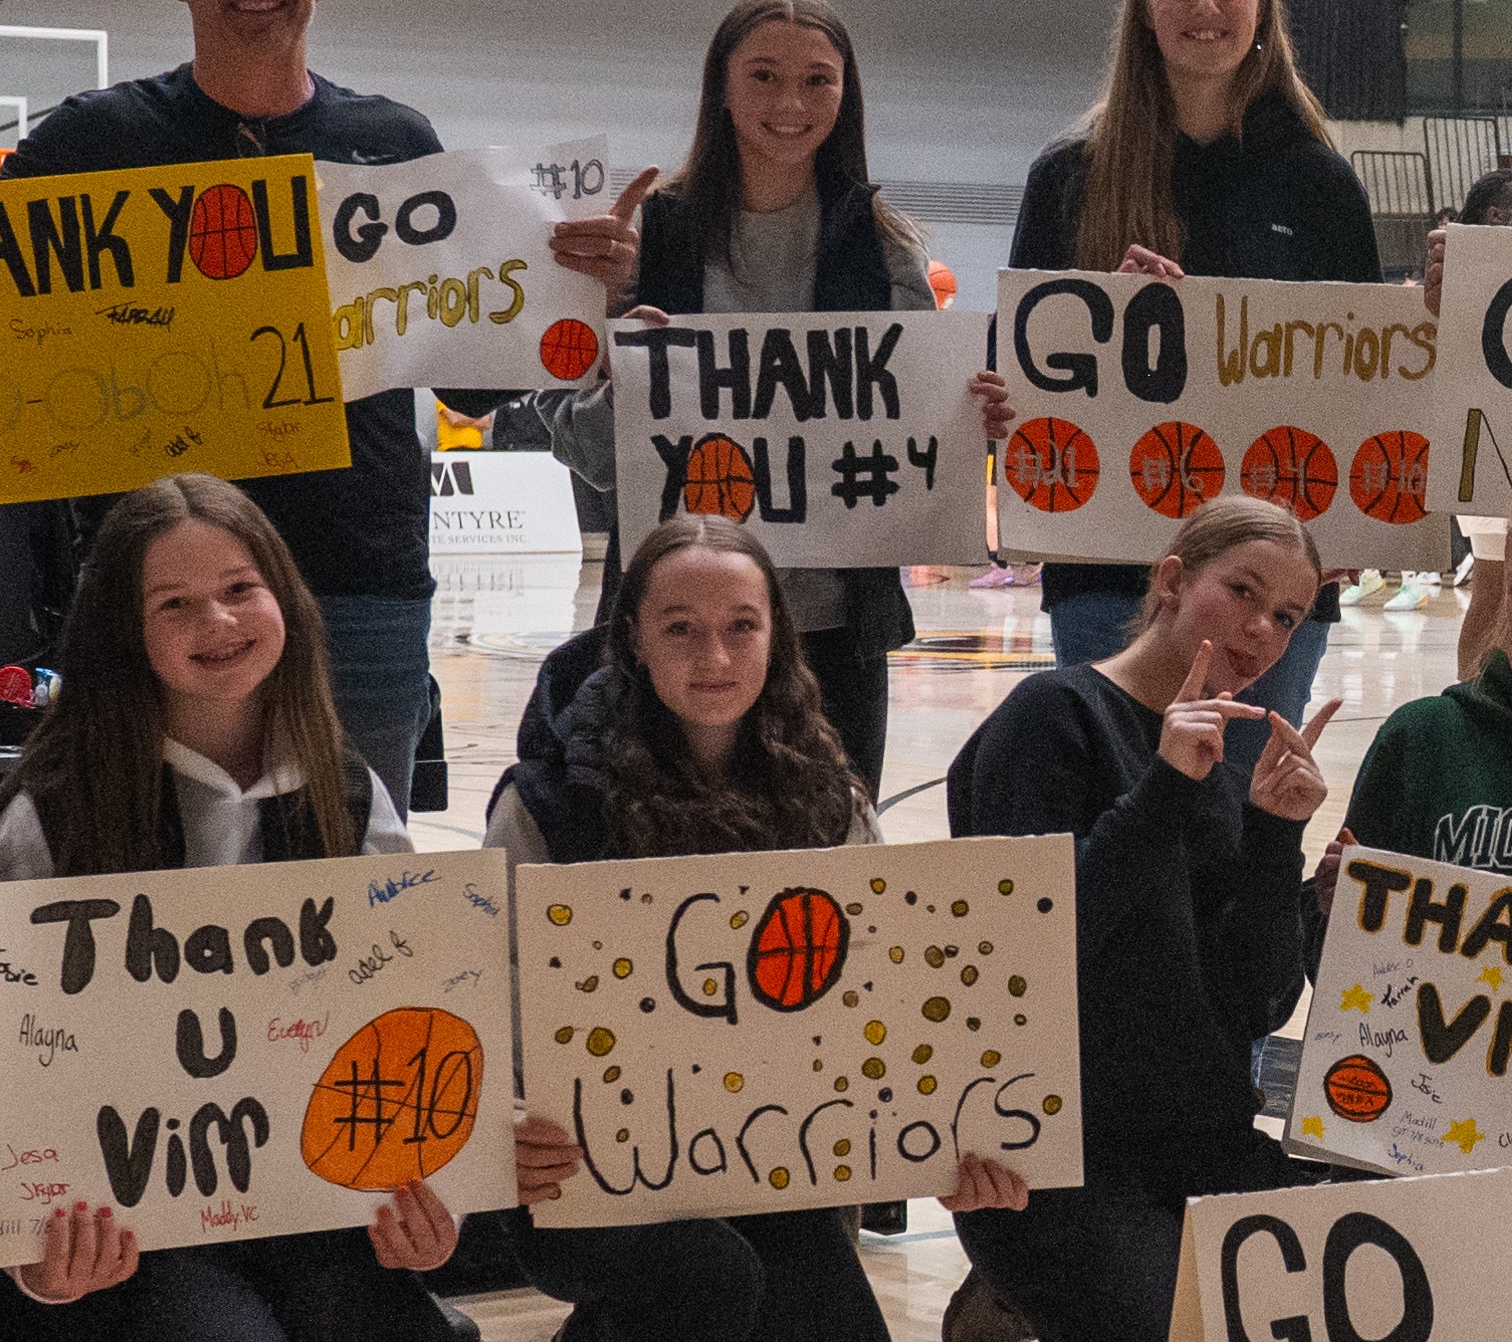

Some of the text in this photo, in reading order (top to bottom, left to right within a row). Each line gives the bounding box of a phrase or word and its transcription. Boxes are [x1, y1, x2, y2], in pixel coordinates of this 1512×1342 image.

[529, 159, 605, 200] #10
[332, 189, 458, 262] GO
[332, 258, 528, 352] arriors
[1013, 278, 1189, 405] GO
[249, 322, 335, 410] 21
[613, 322, 904, 423] THANK
[432, 509, 524, 531] NTYRE
[448, 534, 503, 545] SERVICES
[29, 893, 339, 995] Thank
[18, 1013, 79, 1068] Alayna
[1358, 1021, 1409, 1059] Alayna
[333, 1048, 474, 1153] #10
[1, 1143, 61, 1171] Jesa
